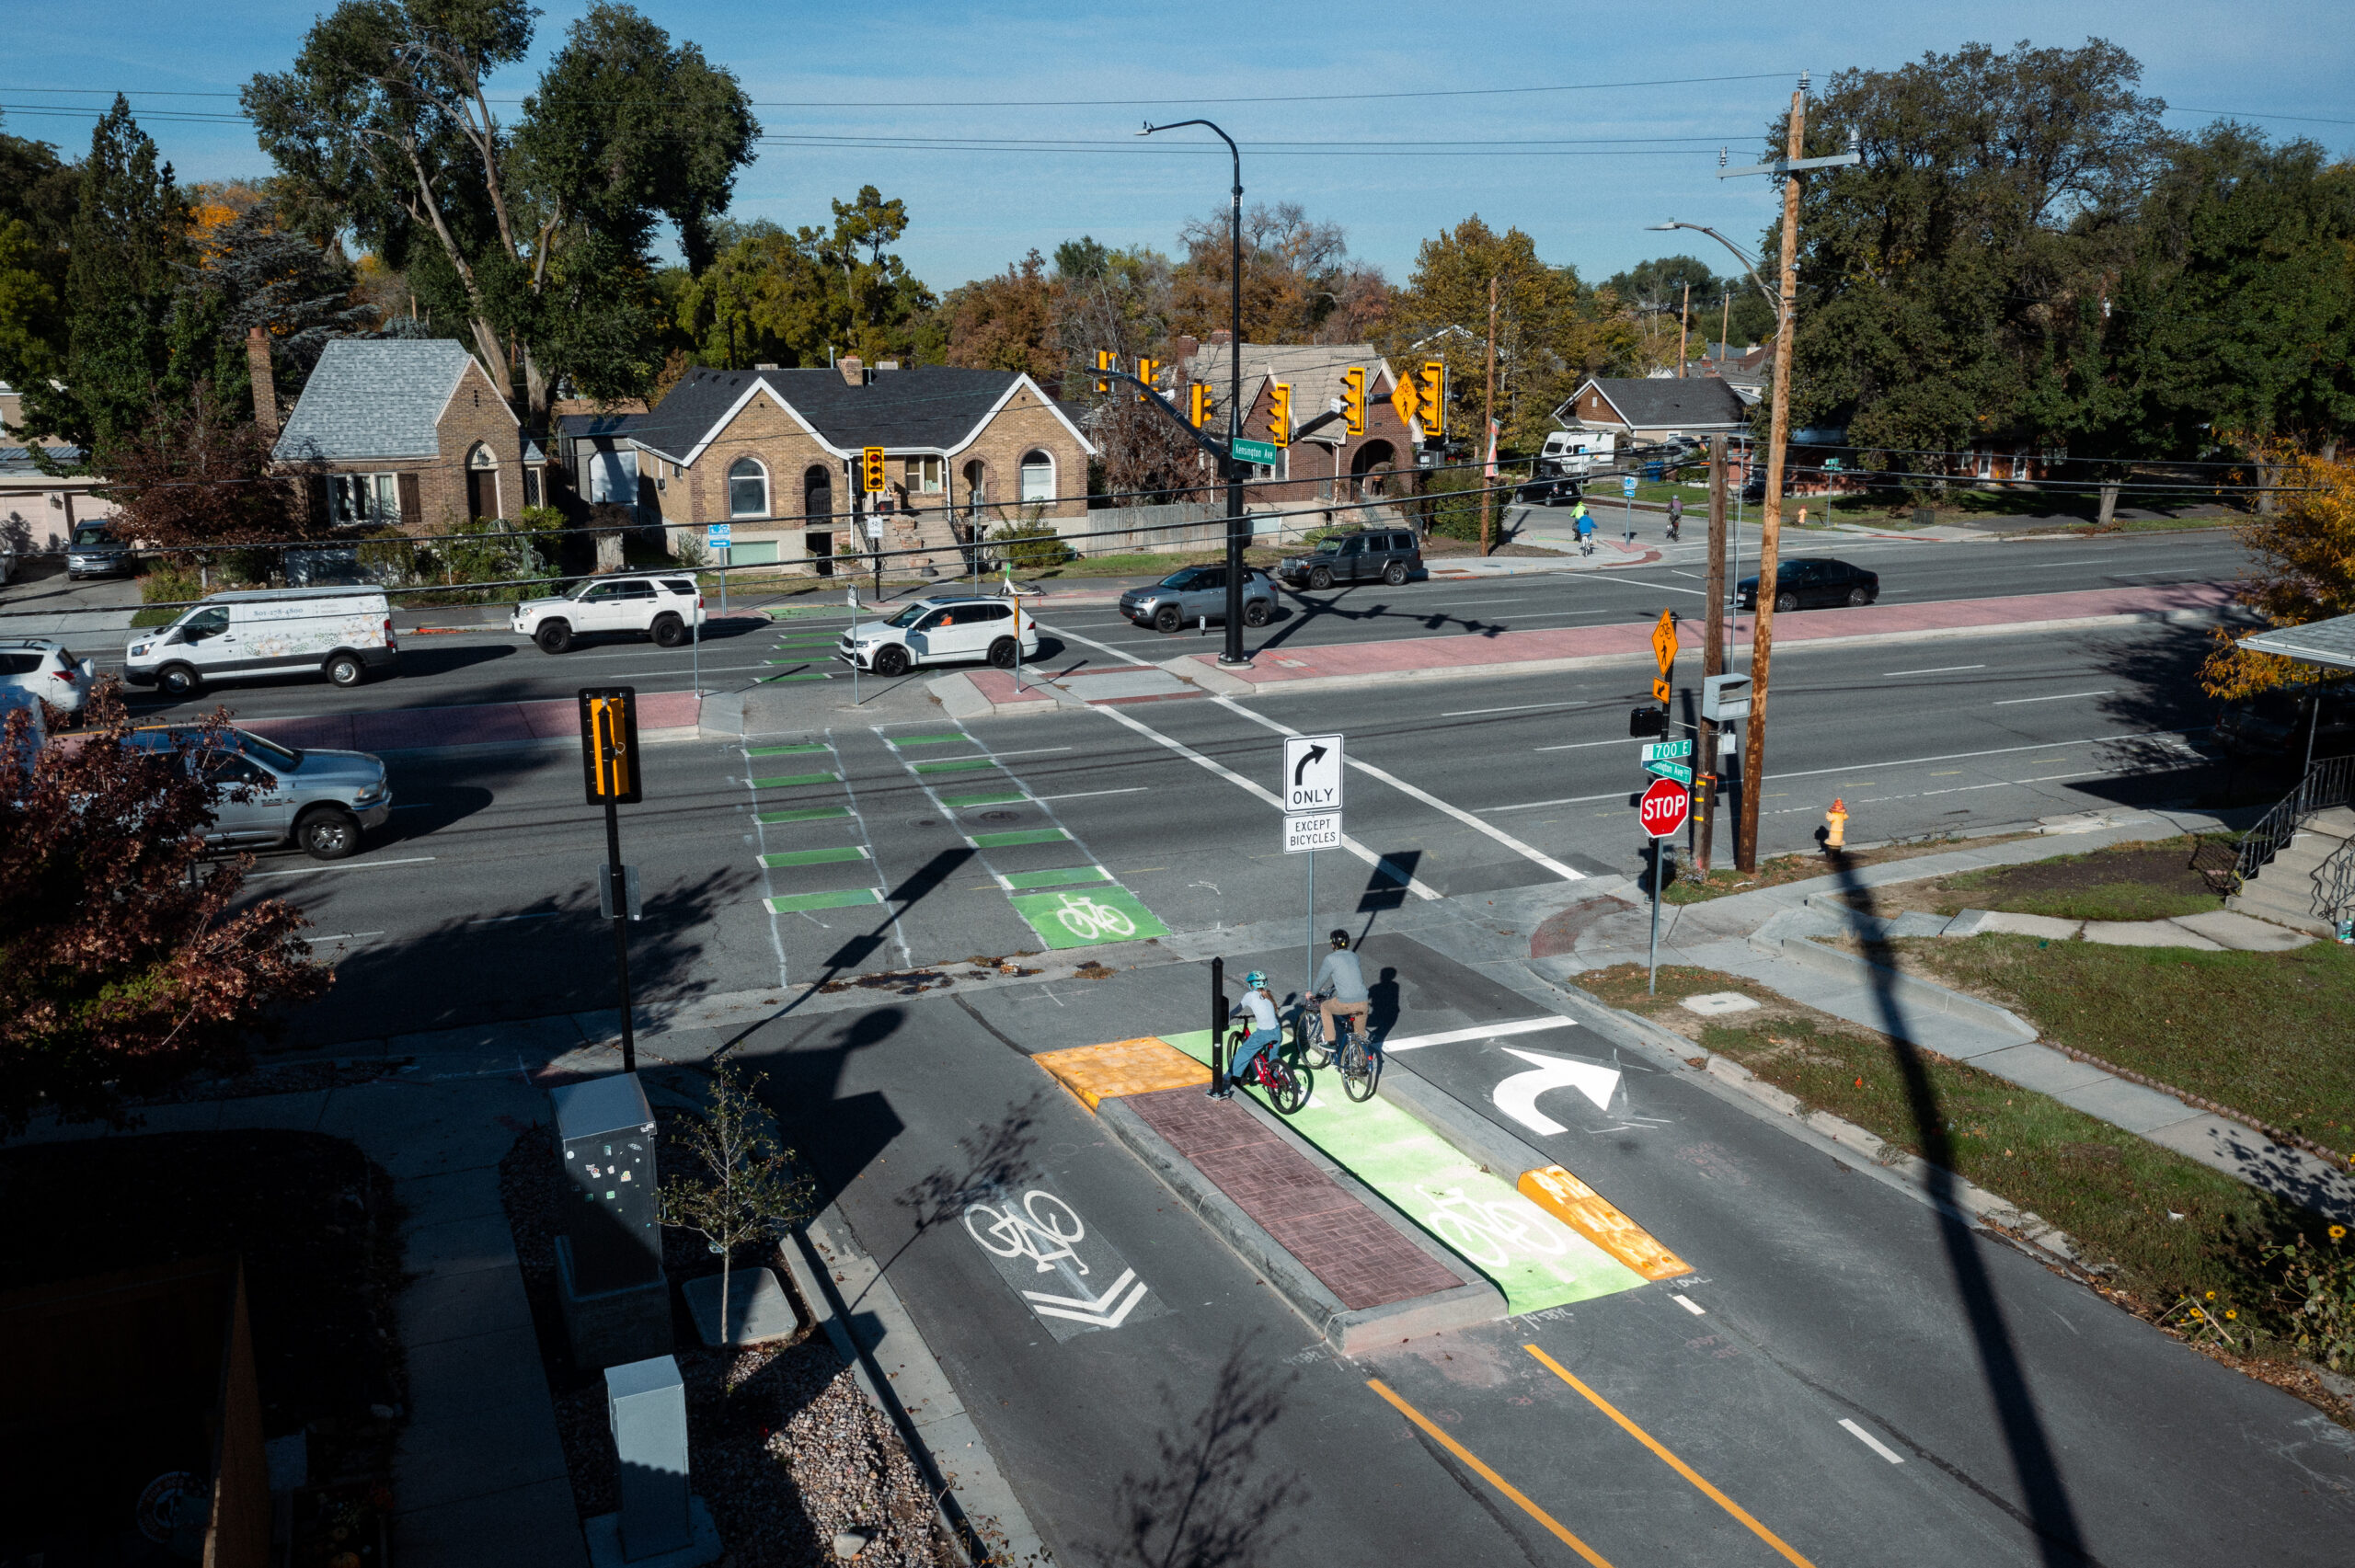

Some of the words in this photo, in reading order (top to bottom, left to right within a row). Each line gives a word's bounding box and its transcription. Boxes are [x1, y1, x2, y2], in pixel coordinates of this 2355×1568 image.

[1235, 444, 1261, 459] Kensington
[1264, 449, 1273, 460] Ave
[1656, 742, 1677, 759] 700
[1683, 741, 1689, 755] E
[1674, 766, 1683, 777] Ave
[1292, 787, 1334, 805] ONLY
[1643, 795, 1686, 821] STOP
[1295, 818, 1331, 832] EXCEPT
[1290, 831, 1336, 846] BICYCLES
